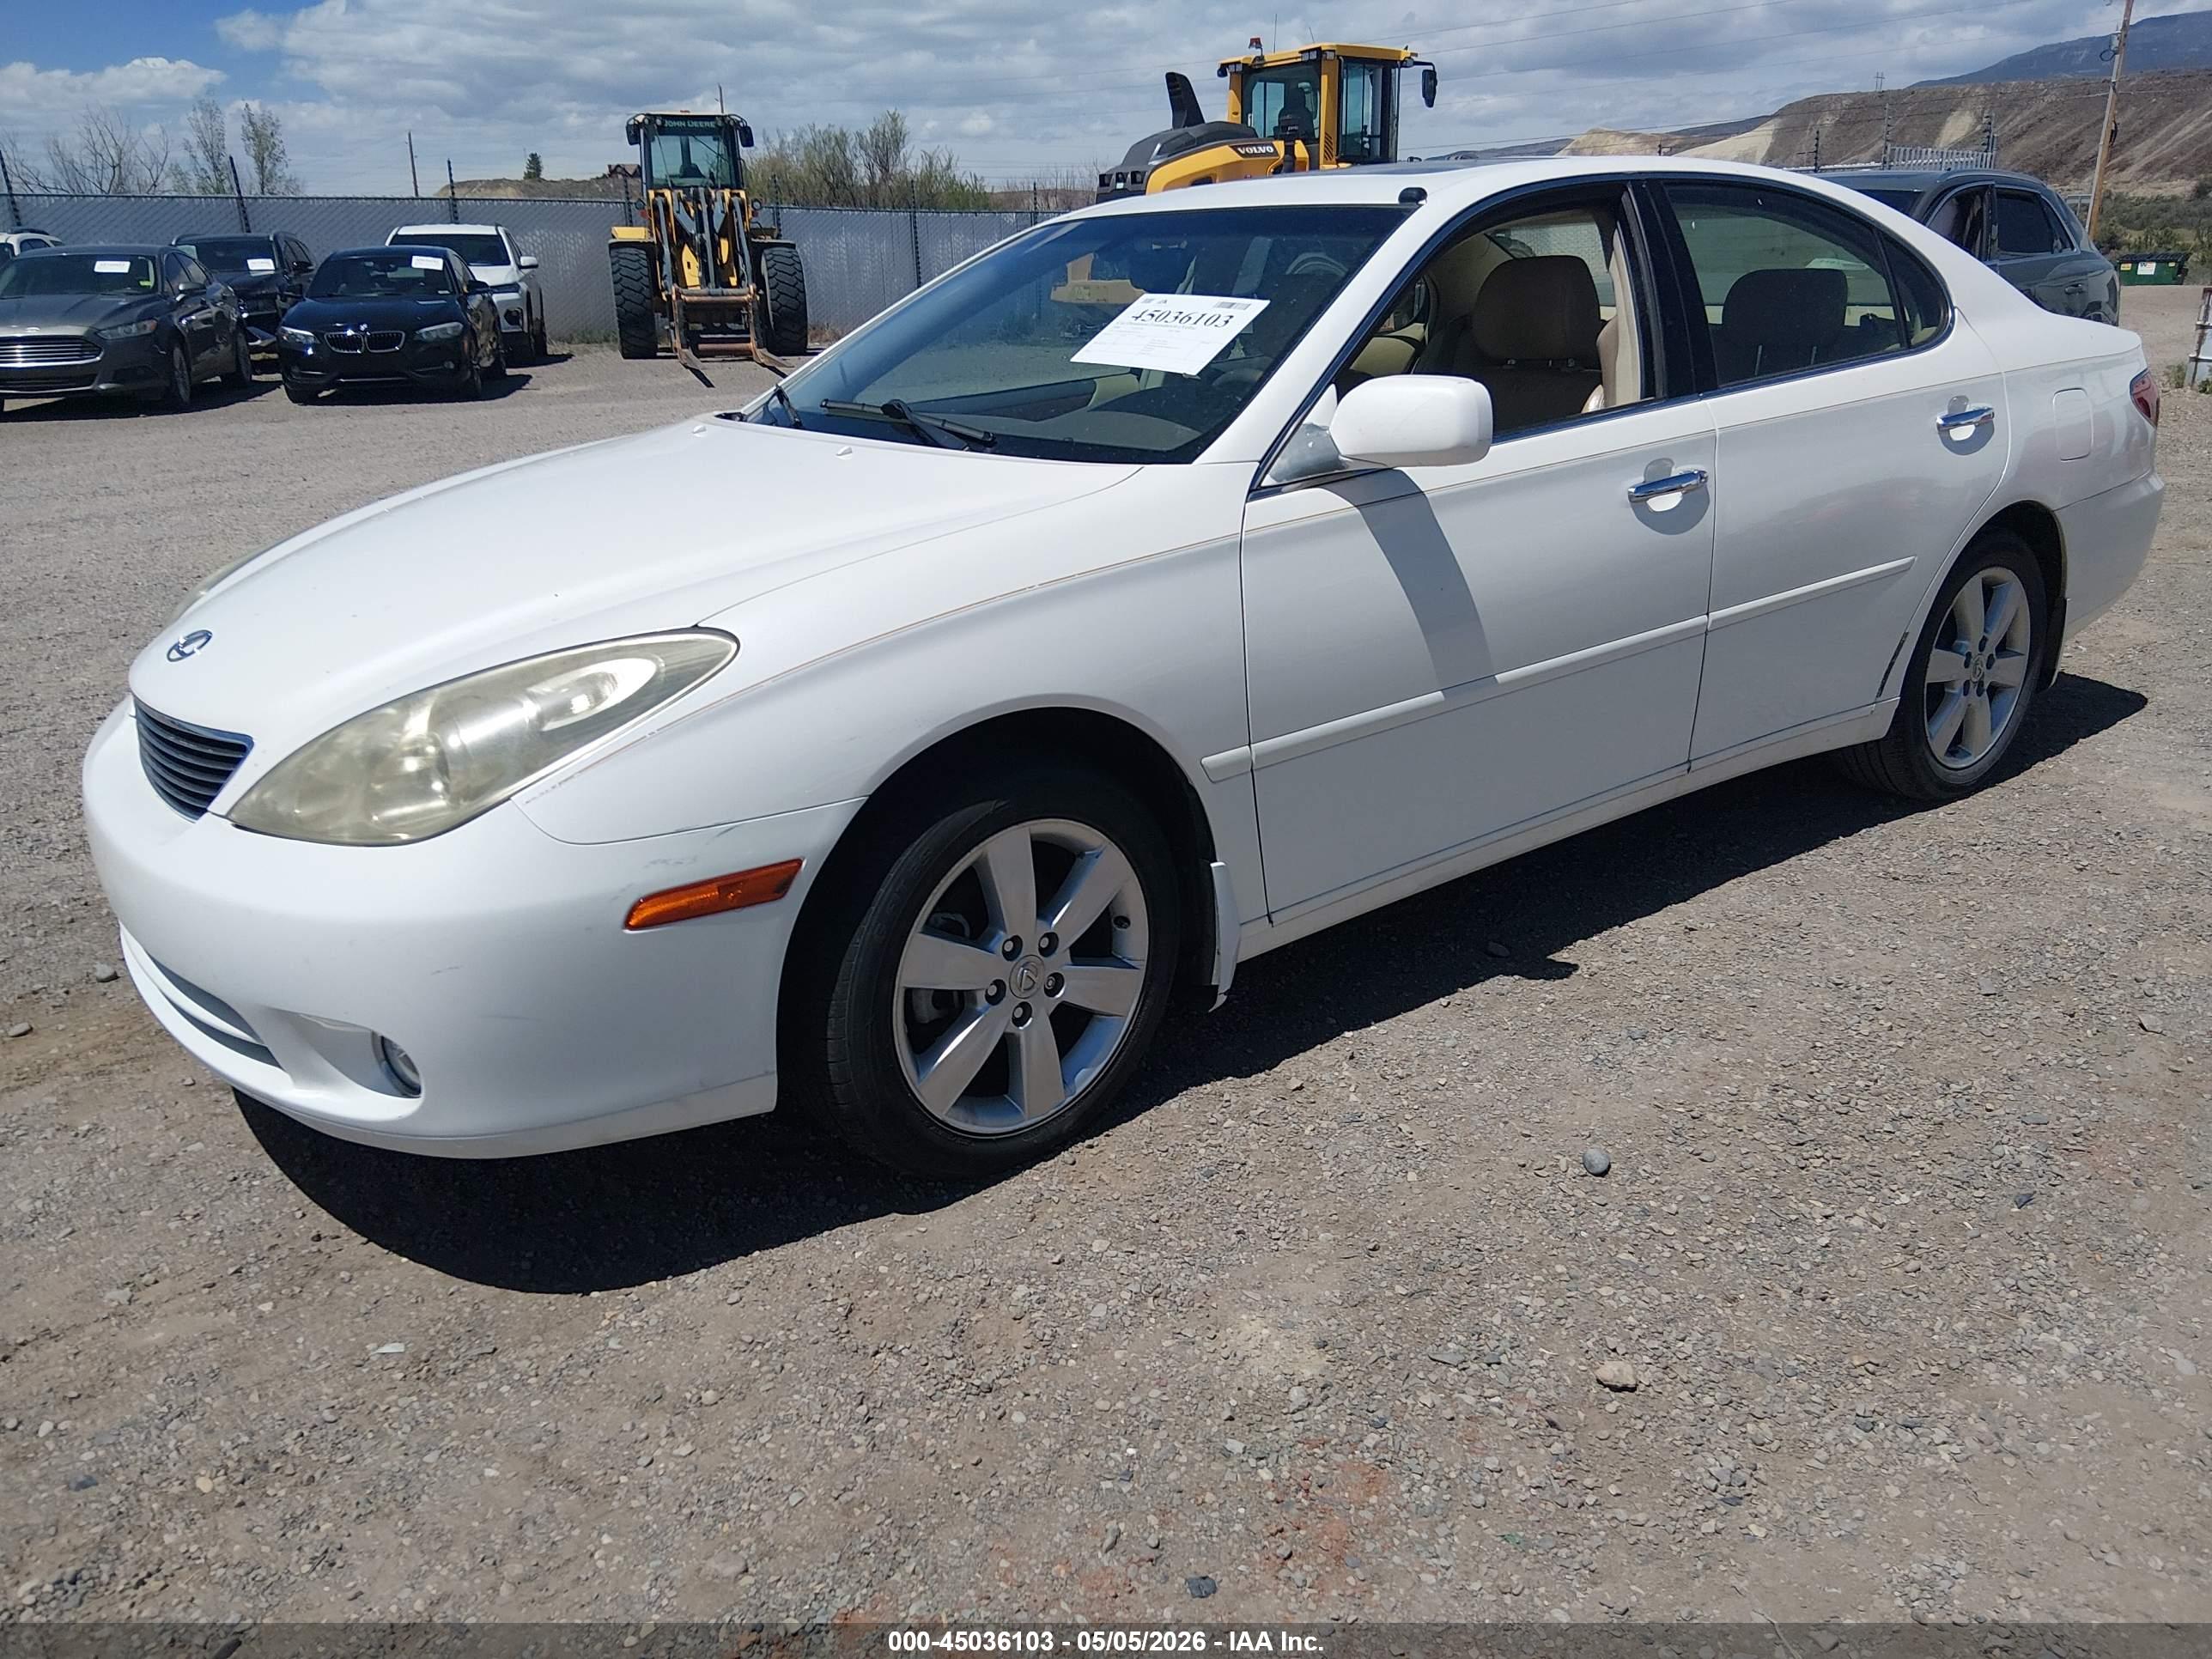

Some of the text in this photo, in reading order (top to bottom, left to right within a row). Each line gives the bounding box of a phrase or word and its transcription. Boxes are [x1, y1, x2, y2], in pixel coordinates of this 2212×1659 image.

[665, 119, 715, 129] JOHN DEERE
[1237, 145, 1274, 155] VOLVO
[1131, 308, 1235, 329] 45036103
